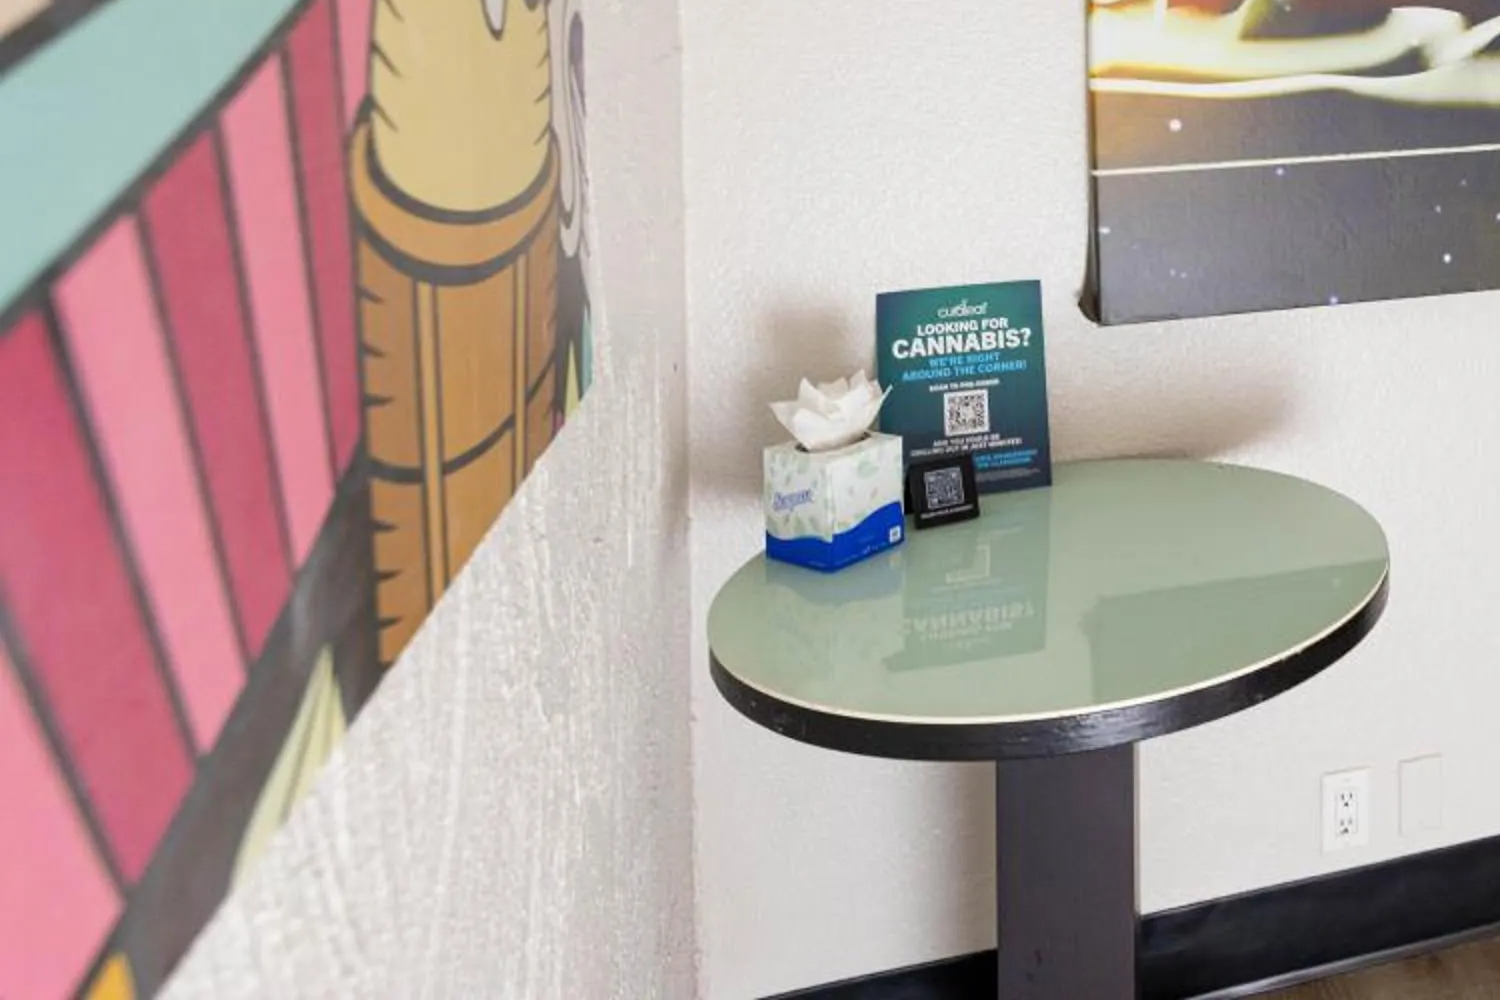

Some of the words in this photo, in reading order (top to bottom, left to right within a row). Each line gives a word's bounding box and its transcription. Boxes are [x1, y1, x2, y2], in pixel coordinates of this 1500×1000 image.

[917, 320, 978, 337] LOOKING
[982, 317, 1009, 330] FOR
[892, 328, 1032, 359] CANNABIS?
[902, 367, 951, 381] AROUND
[954, 366, 977, 376] THE
